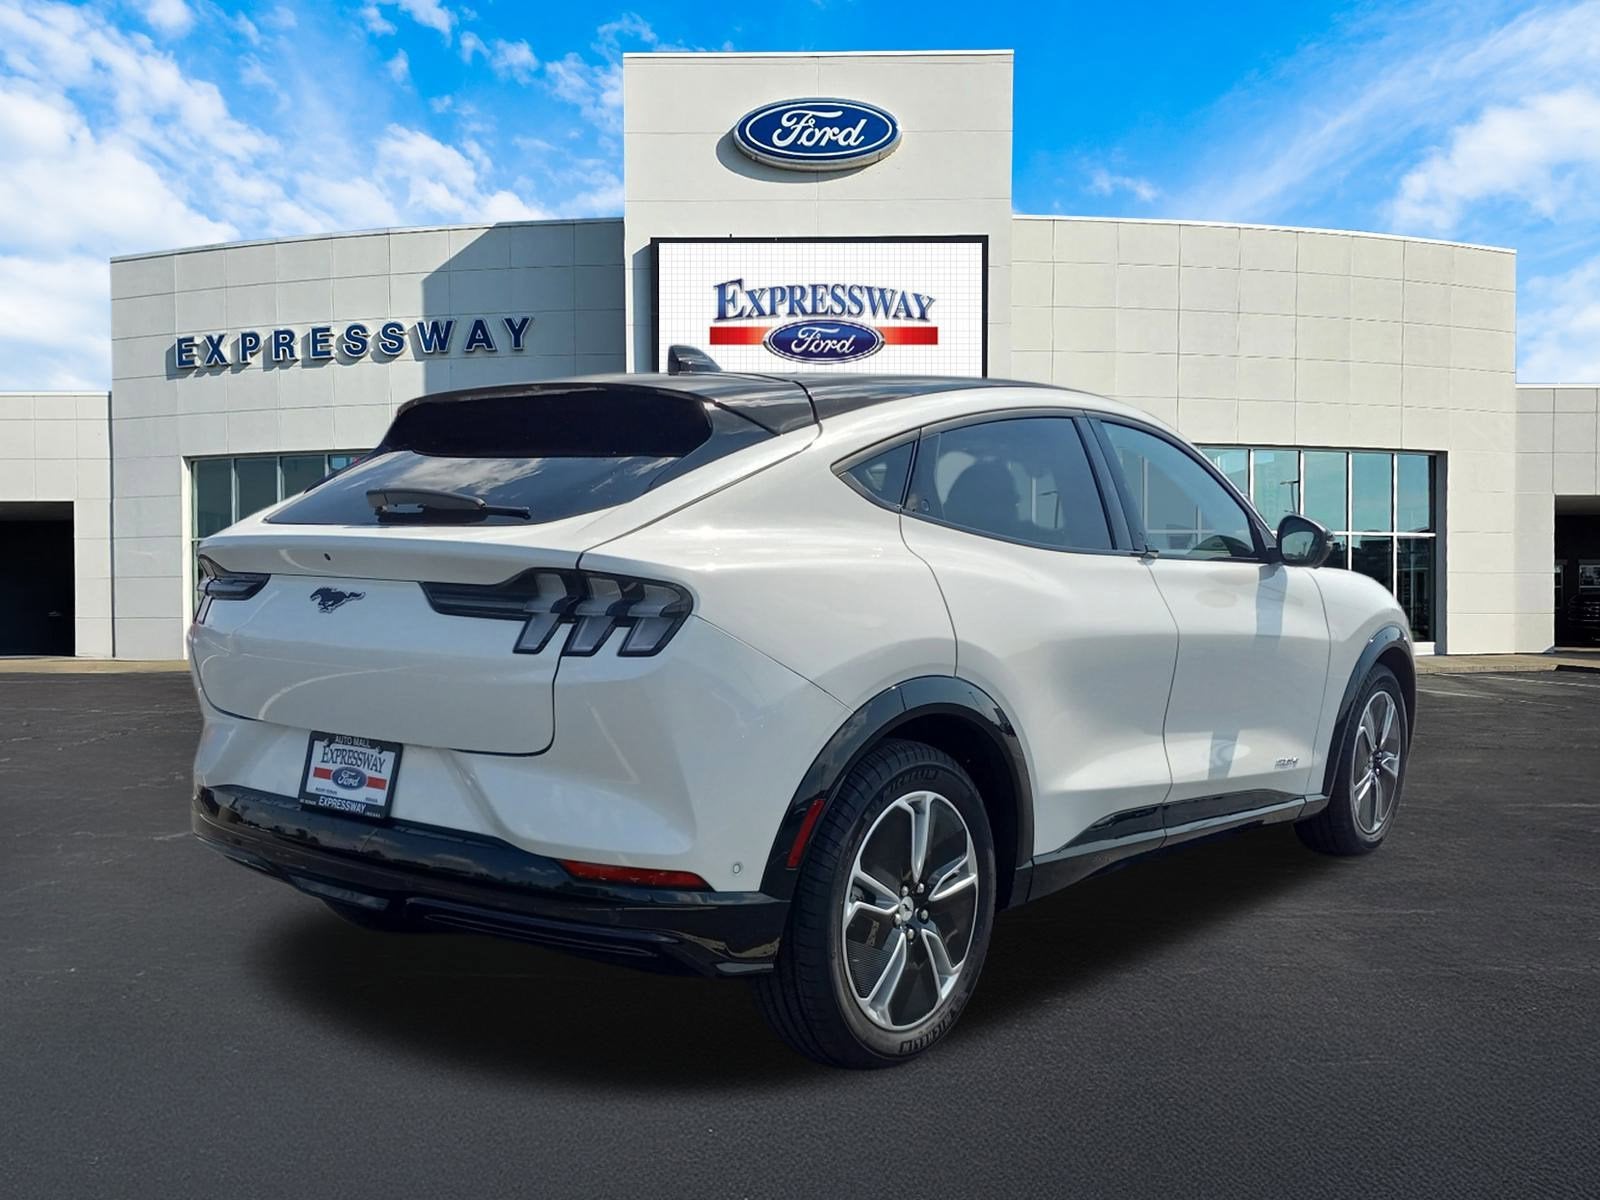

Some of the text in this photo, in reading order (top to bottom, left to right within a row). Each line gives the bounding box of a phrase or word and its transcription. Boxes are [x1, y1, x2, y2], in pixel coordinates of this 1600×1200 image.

[771, 109, 867, 148] Ford
[713, 278, 936, 323] EXPRESSWAY
[174, 315, 534, 369] EXPRESSWAY
[790, 326, 856, 354] Ford
[335, 736, 371, 748] AUTO MALL
[320, 745, 386, 773] EXPRESSWAY
[337, 769, 361, 787] Ford
[318, 796, 366, 814] EXPRESSWAY
